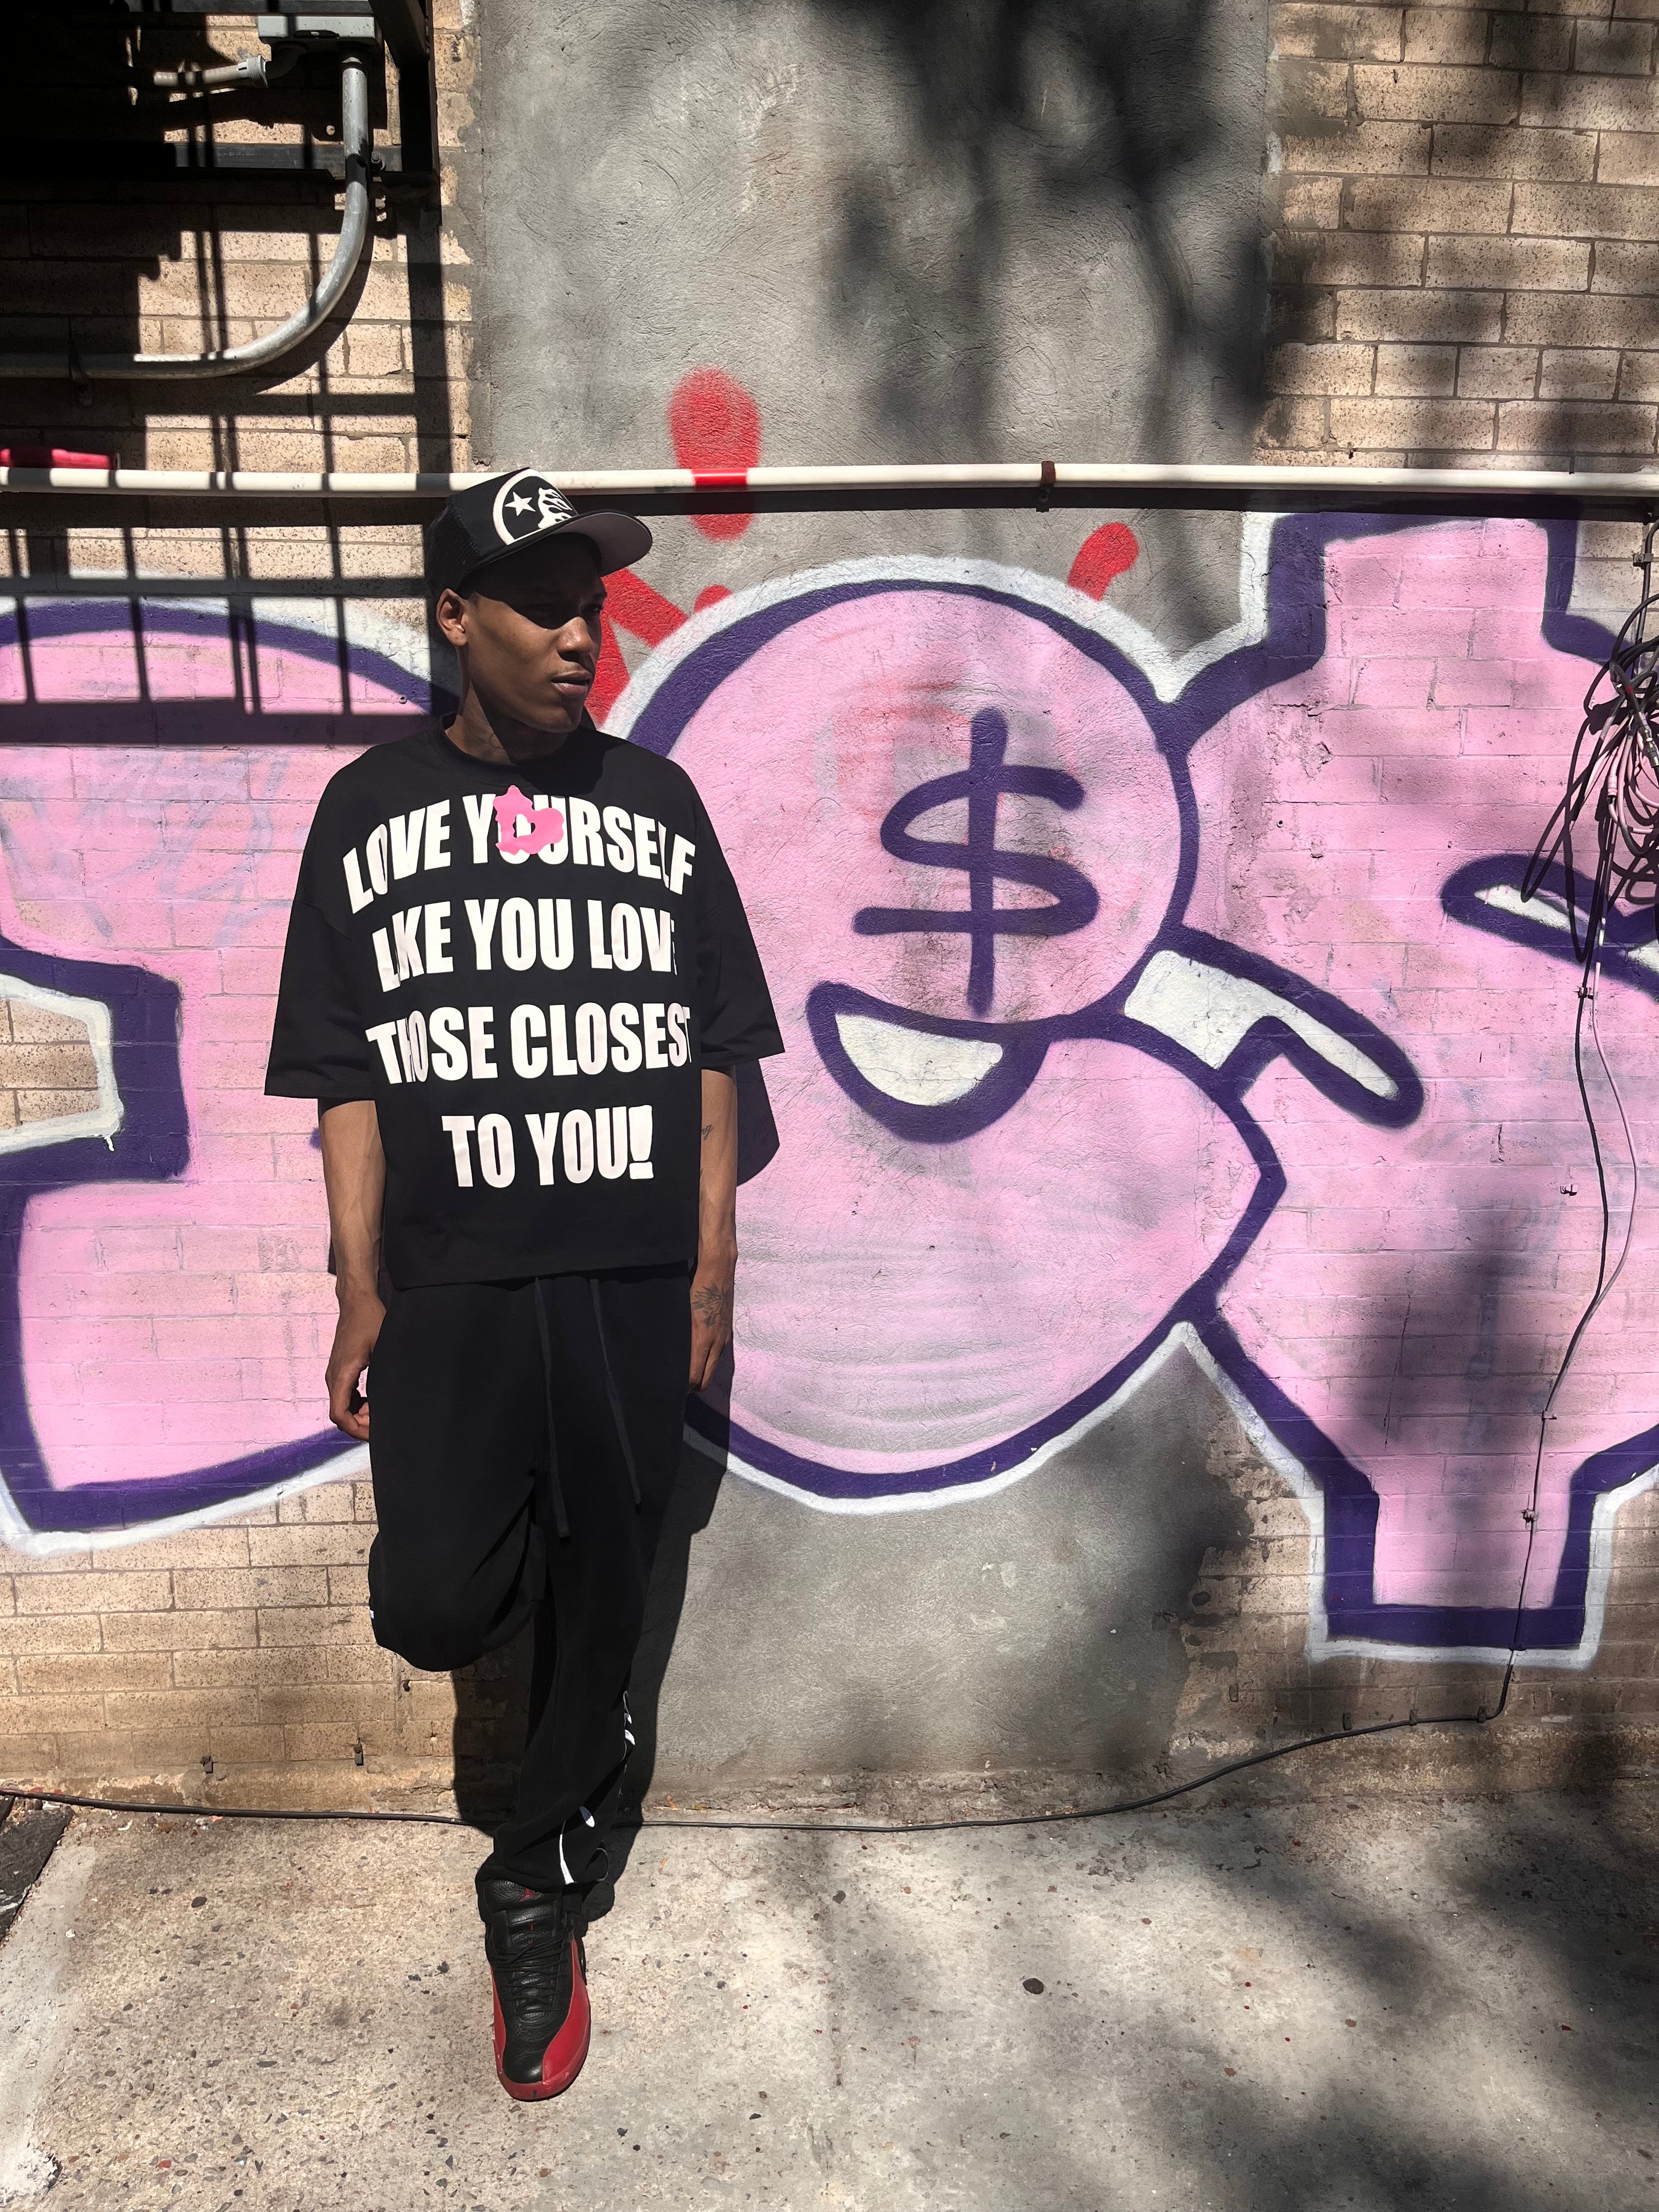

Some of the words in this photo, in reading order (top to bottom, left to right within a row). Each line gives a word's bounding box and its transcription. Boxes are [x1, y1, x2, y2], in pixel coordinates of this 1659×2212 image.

[342, 799, 451, 914] LOVE
[372, 901, 454, 992] LKE
[464, 897, 574, 971] YOU
[587, 899, 678, 975] LOV
[441, 1113, 515, 1188] TO
[524, 1104, 654, 1186] YOU!
